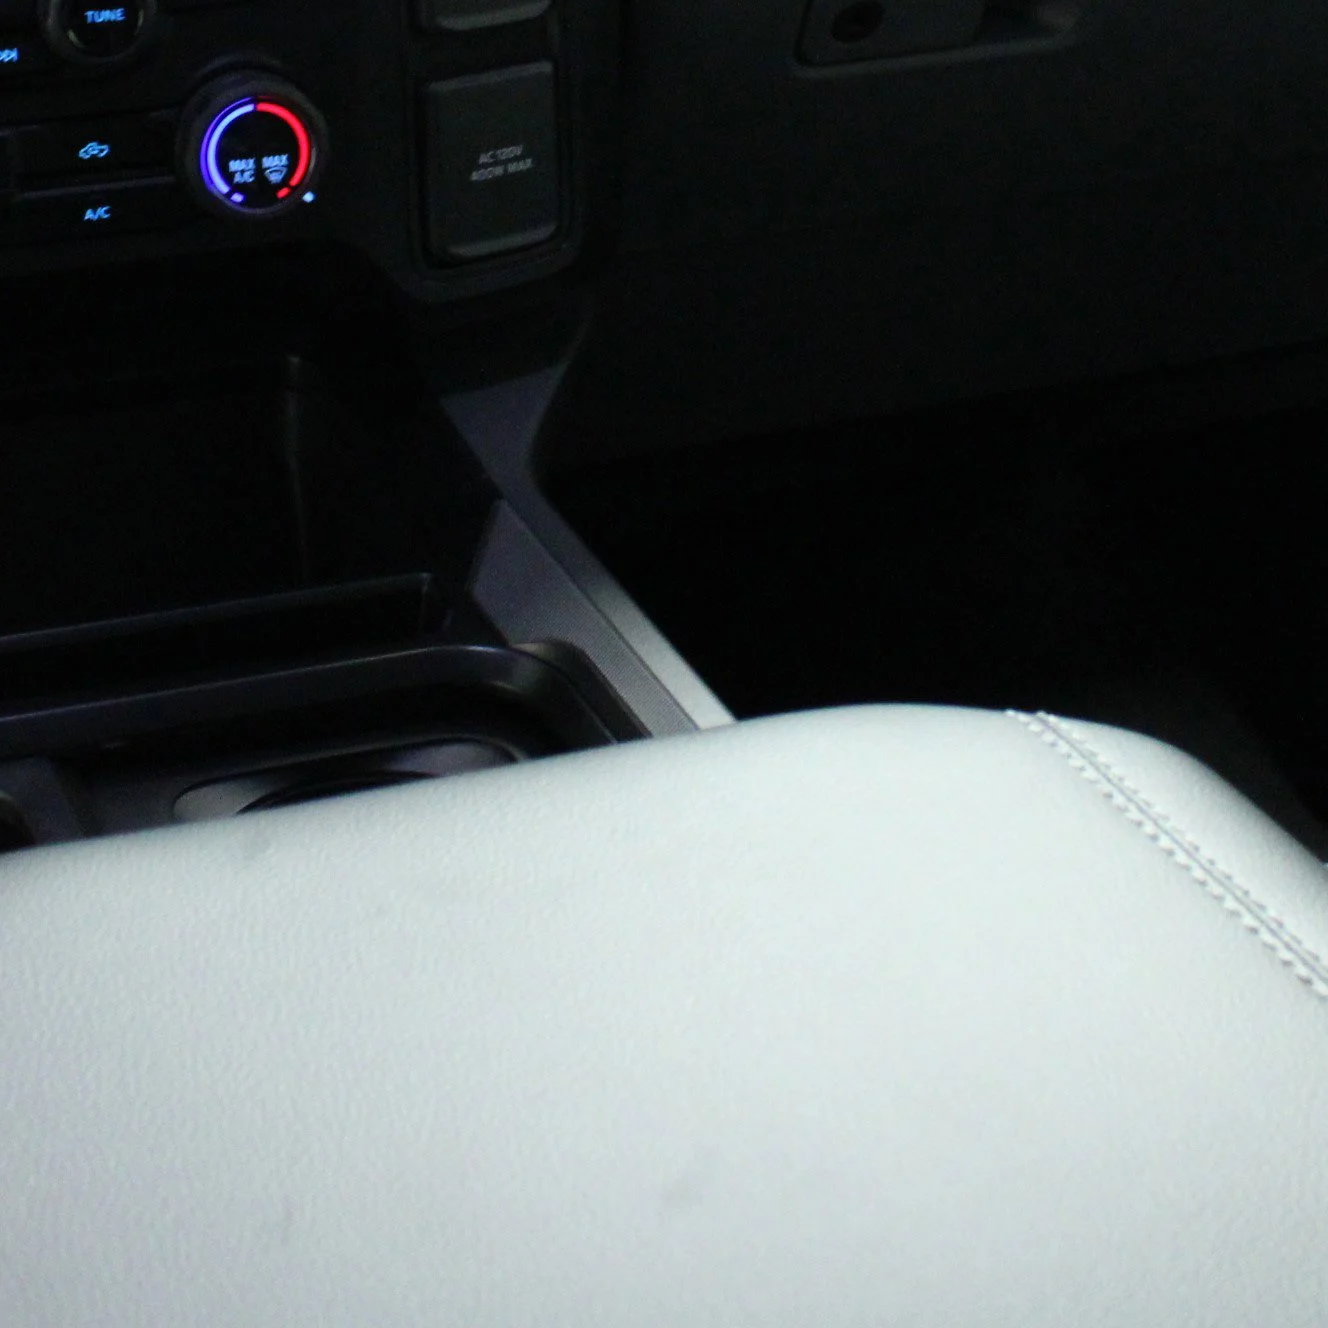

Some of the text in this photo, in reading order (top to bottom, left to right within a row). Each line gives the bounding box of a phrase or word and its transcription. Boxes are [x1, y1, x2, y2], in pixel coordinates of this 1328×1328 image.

[84, 7, 126, 24] TUNE
[229, 157, 256, 172] MAX
[261, 154, 289, 168] MAX
[84, 206, 112, 221] A/C
